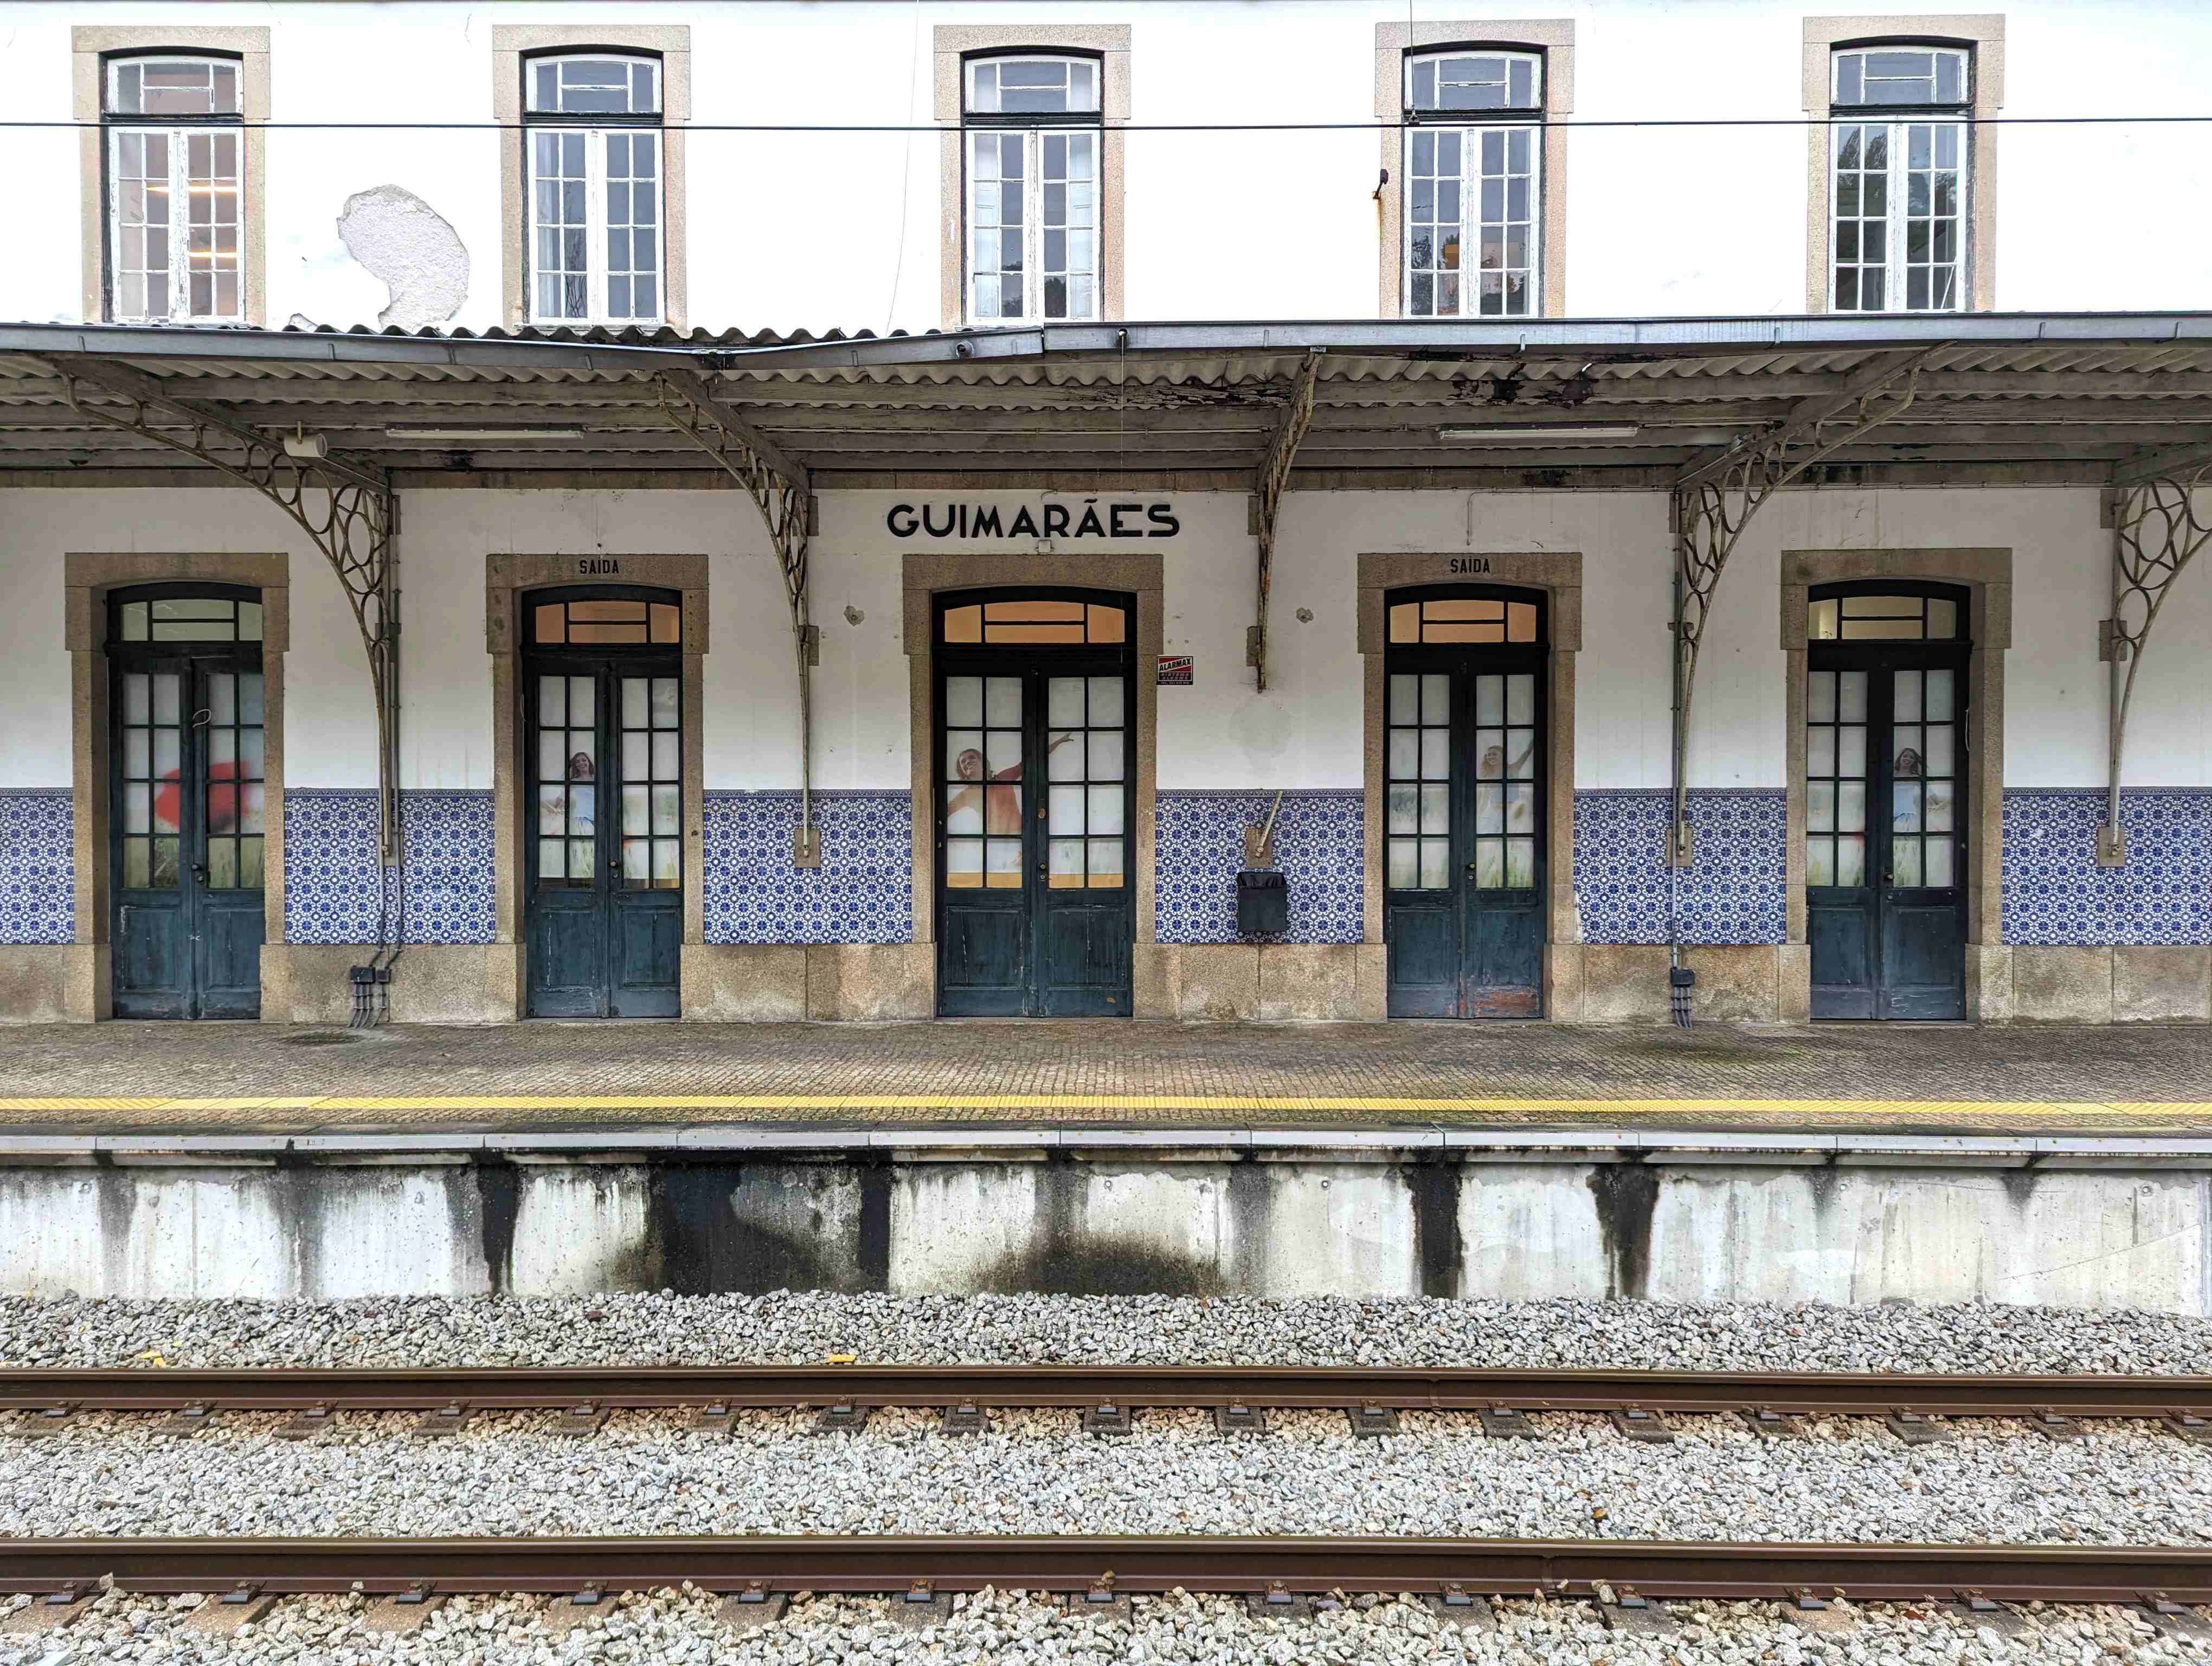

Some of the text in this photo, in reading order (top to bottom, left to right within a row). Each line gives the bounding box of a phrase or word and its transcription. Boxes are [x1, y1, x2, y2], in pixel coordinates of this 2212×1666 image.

[887, 499, 1180, 538] GUIMARÃES
[580, 555, 619, 574] SAÍDA
[1450, 555, 1490, 573] SAÍDA
[1159, 658, 1191, 672] ALARMAX
